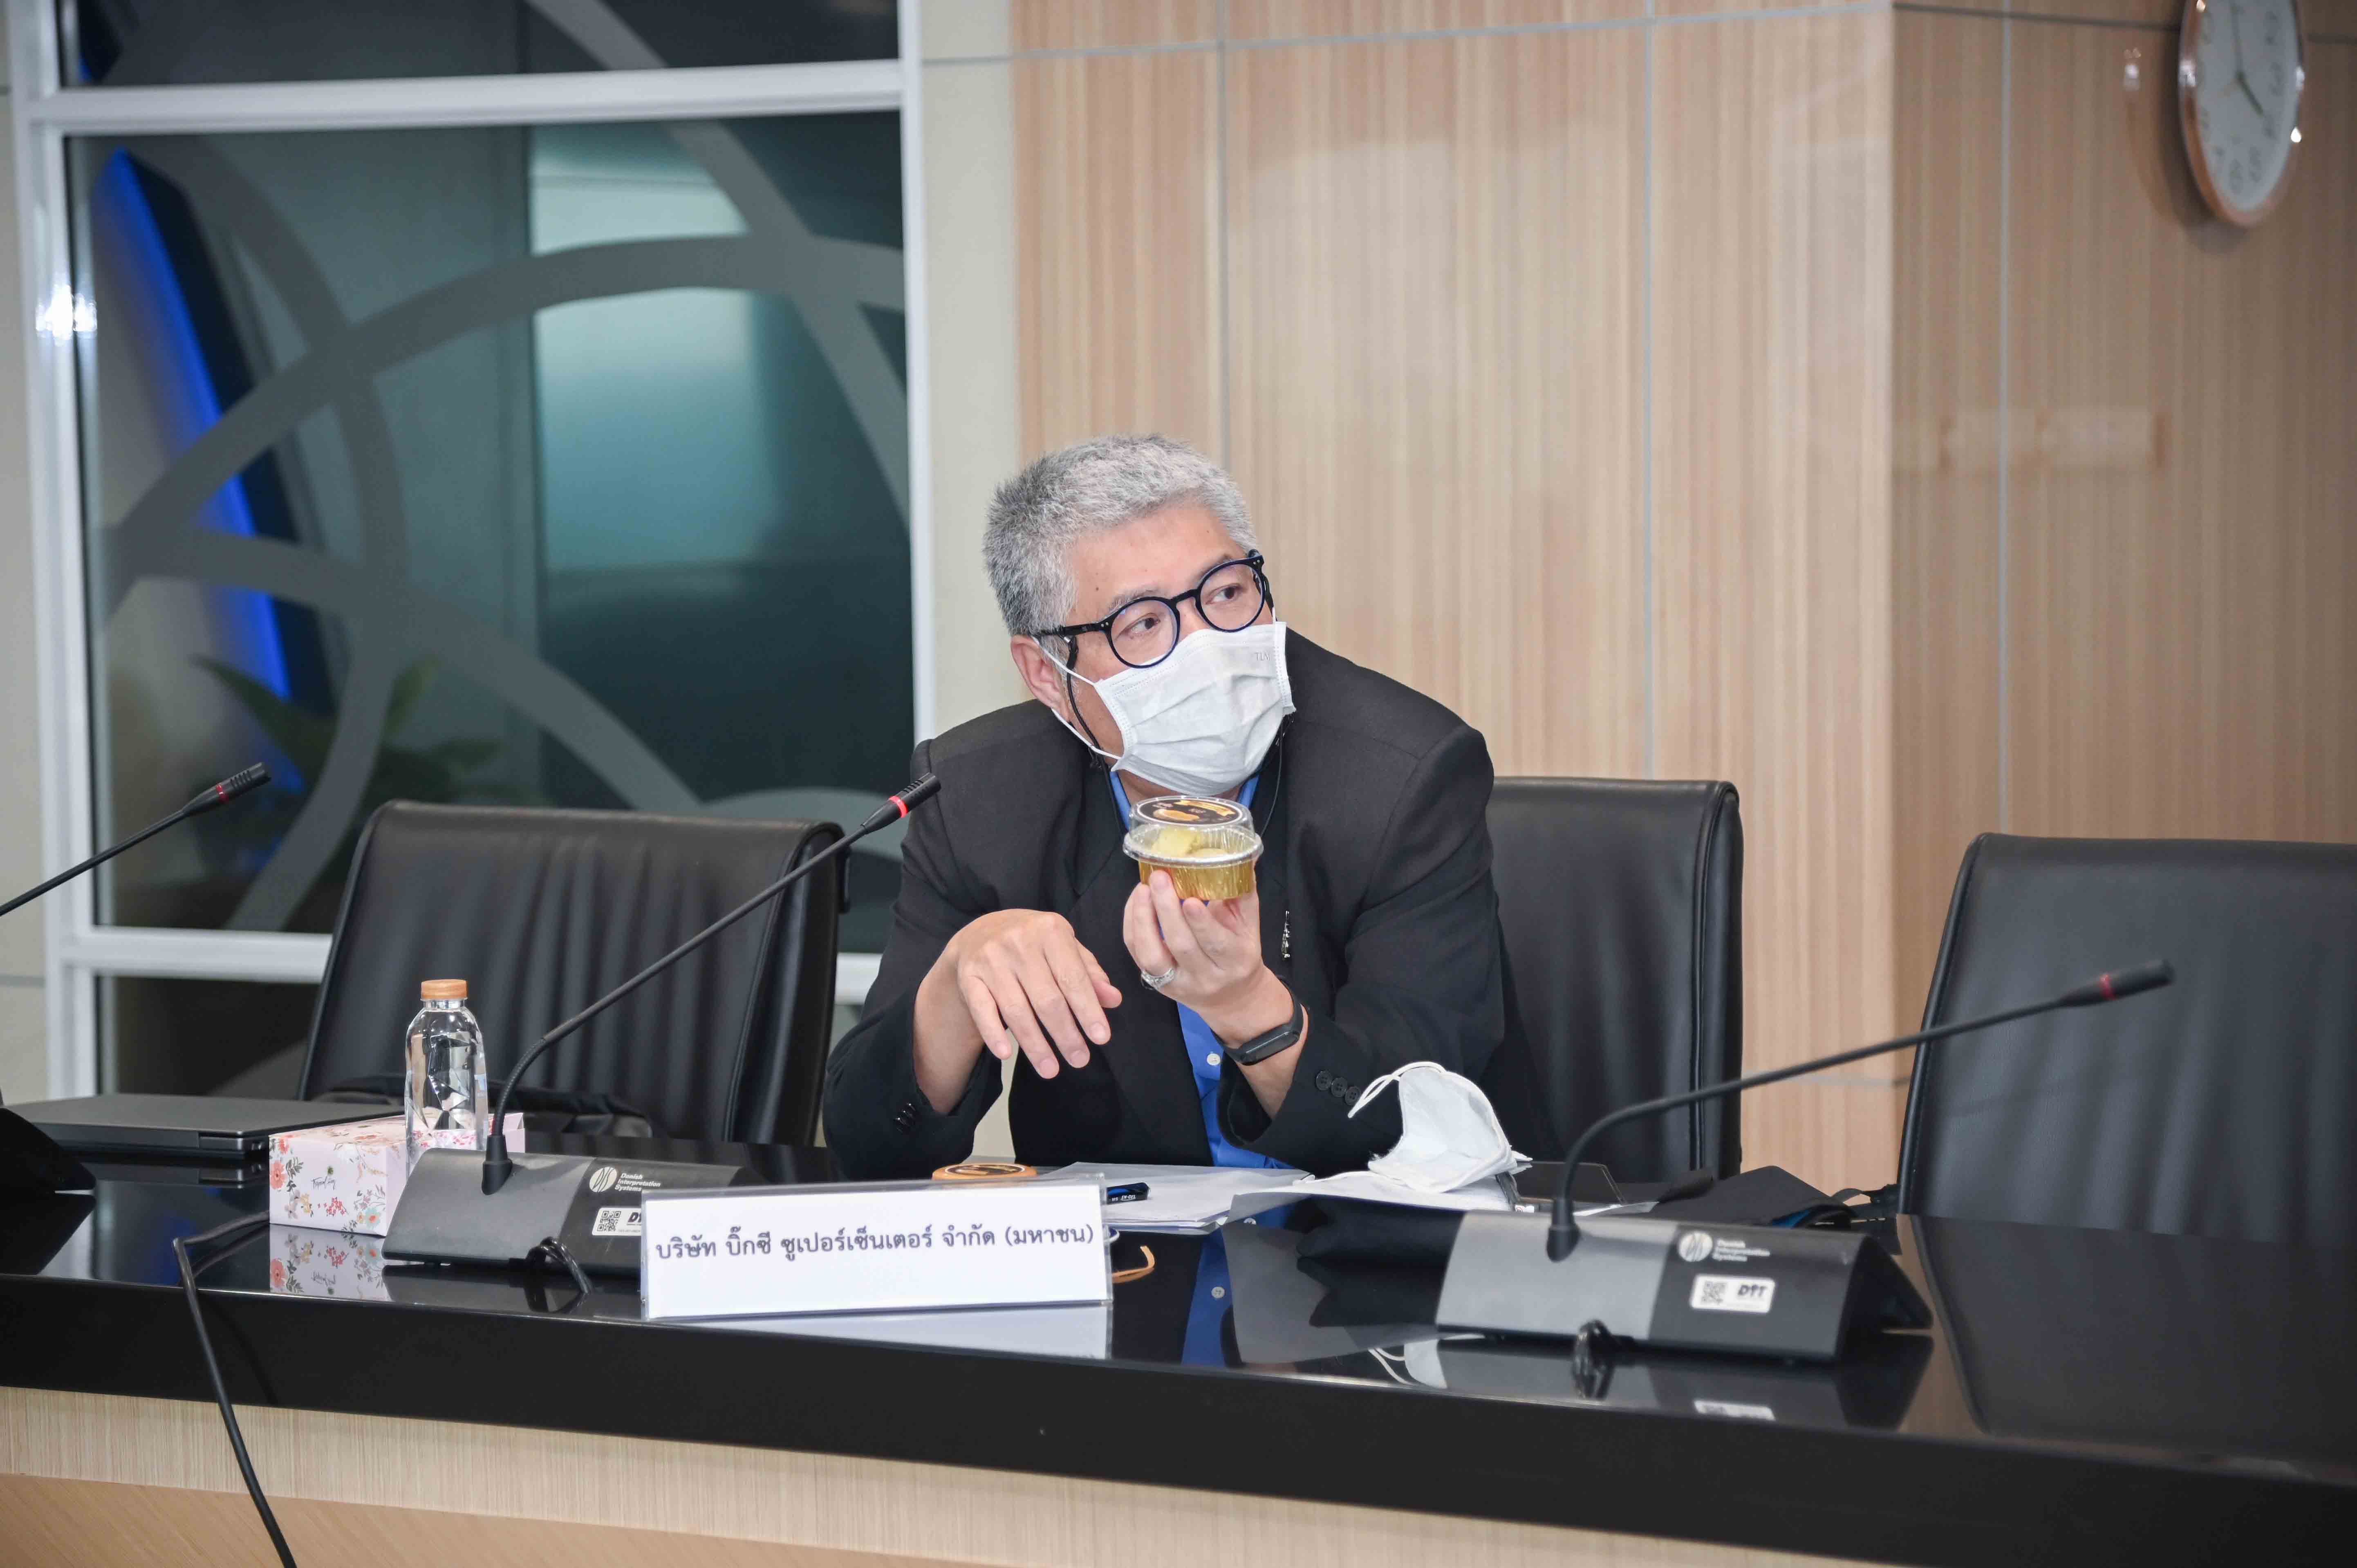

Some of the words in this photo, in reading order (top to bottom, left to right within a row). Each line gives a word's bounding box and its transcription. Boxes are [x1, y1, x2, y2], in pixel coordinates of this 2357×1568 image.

[617, 1178, 661, 1187] Interpretation
[656, 1234, 717, 1259] บริษัท
[726, 1226, 771, 1256] บิ๊กซี
[780, 1224, 932, 1262] ซูเปอร์เซ็นเตอร์
[942, 1223, 995, 1247] จำกัด
[1004, 1223, 1093, 1247] (มหาชน)
